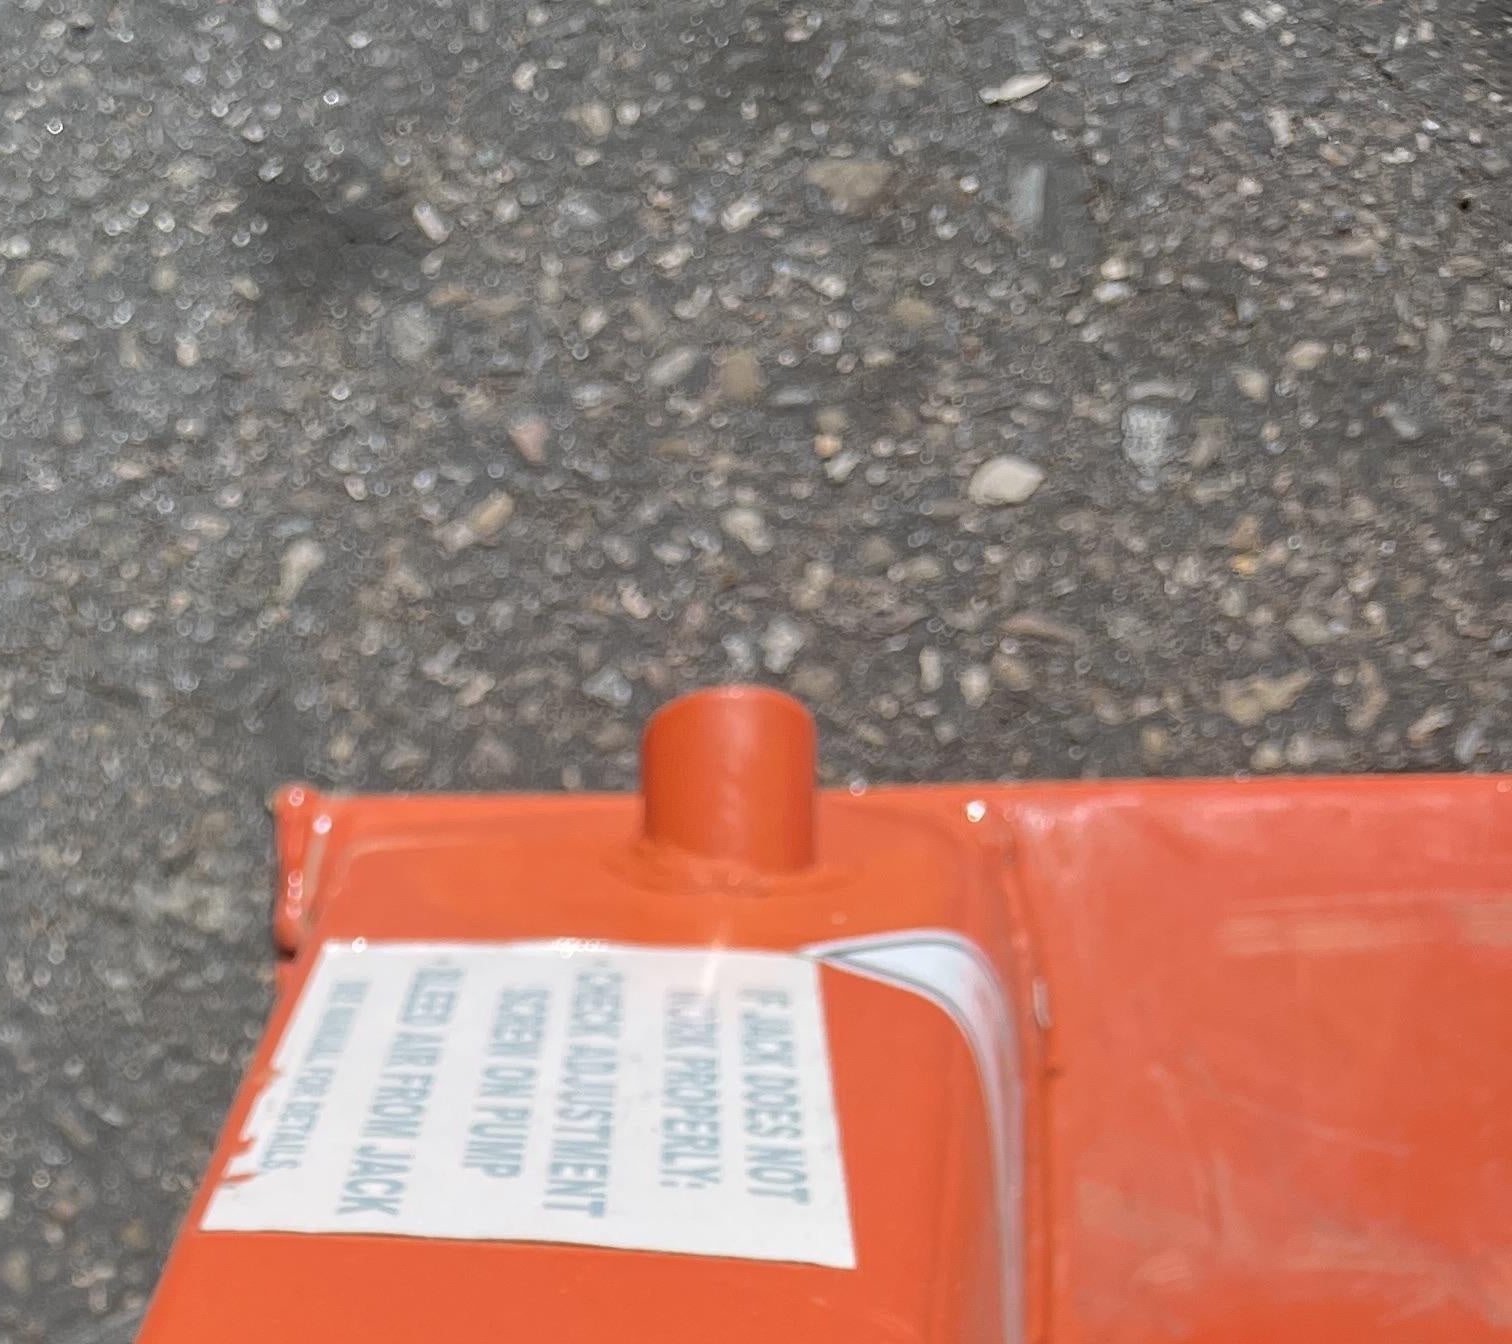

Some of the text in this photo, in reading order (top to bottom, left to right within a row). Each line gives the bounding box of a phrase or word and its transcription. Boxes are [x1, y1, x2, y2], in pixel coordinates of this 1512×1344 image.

[384, 1032, 444, 1067] AIR
[741, 1012, 796, 1067] JACK
[360, 1073, 435, 1138] FROM
[462, 987, 550, 1179] SCREW ON PUMP
[543, 971, 624, 1218] CHECK ADJUSTMENT
[743, 1073, 802, 1139] DOES
[660, 1055, 722, 1190] PROPERLY:
[336, 1144, 413, 1217] JACK
[746, 1145, 810, 1204] NOT
